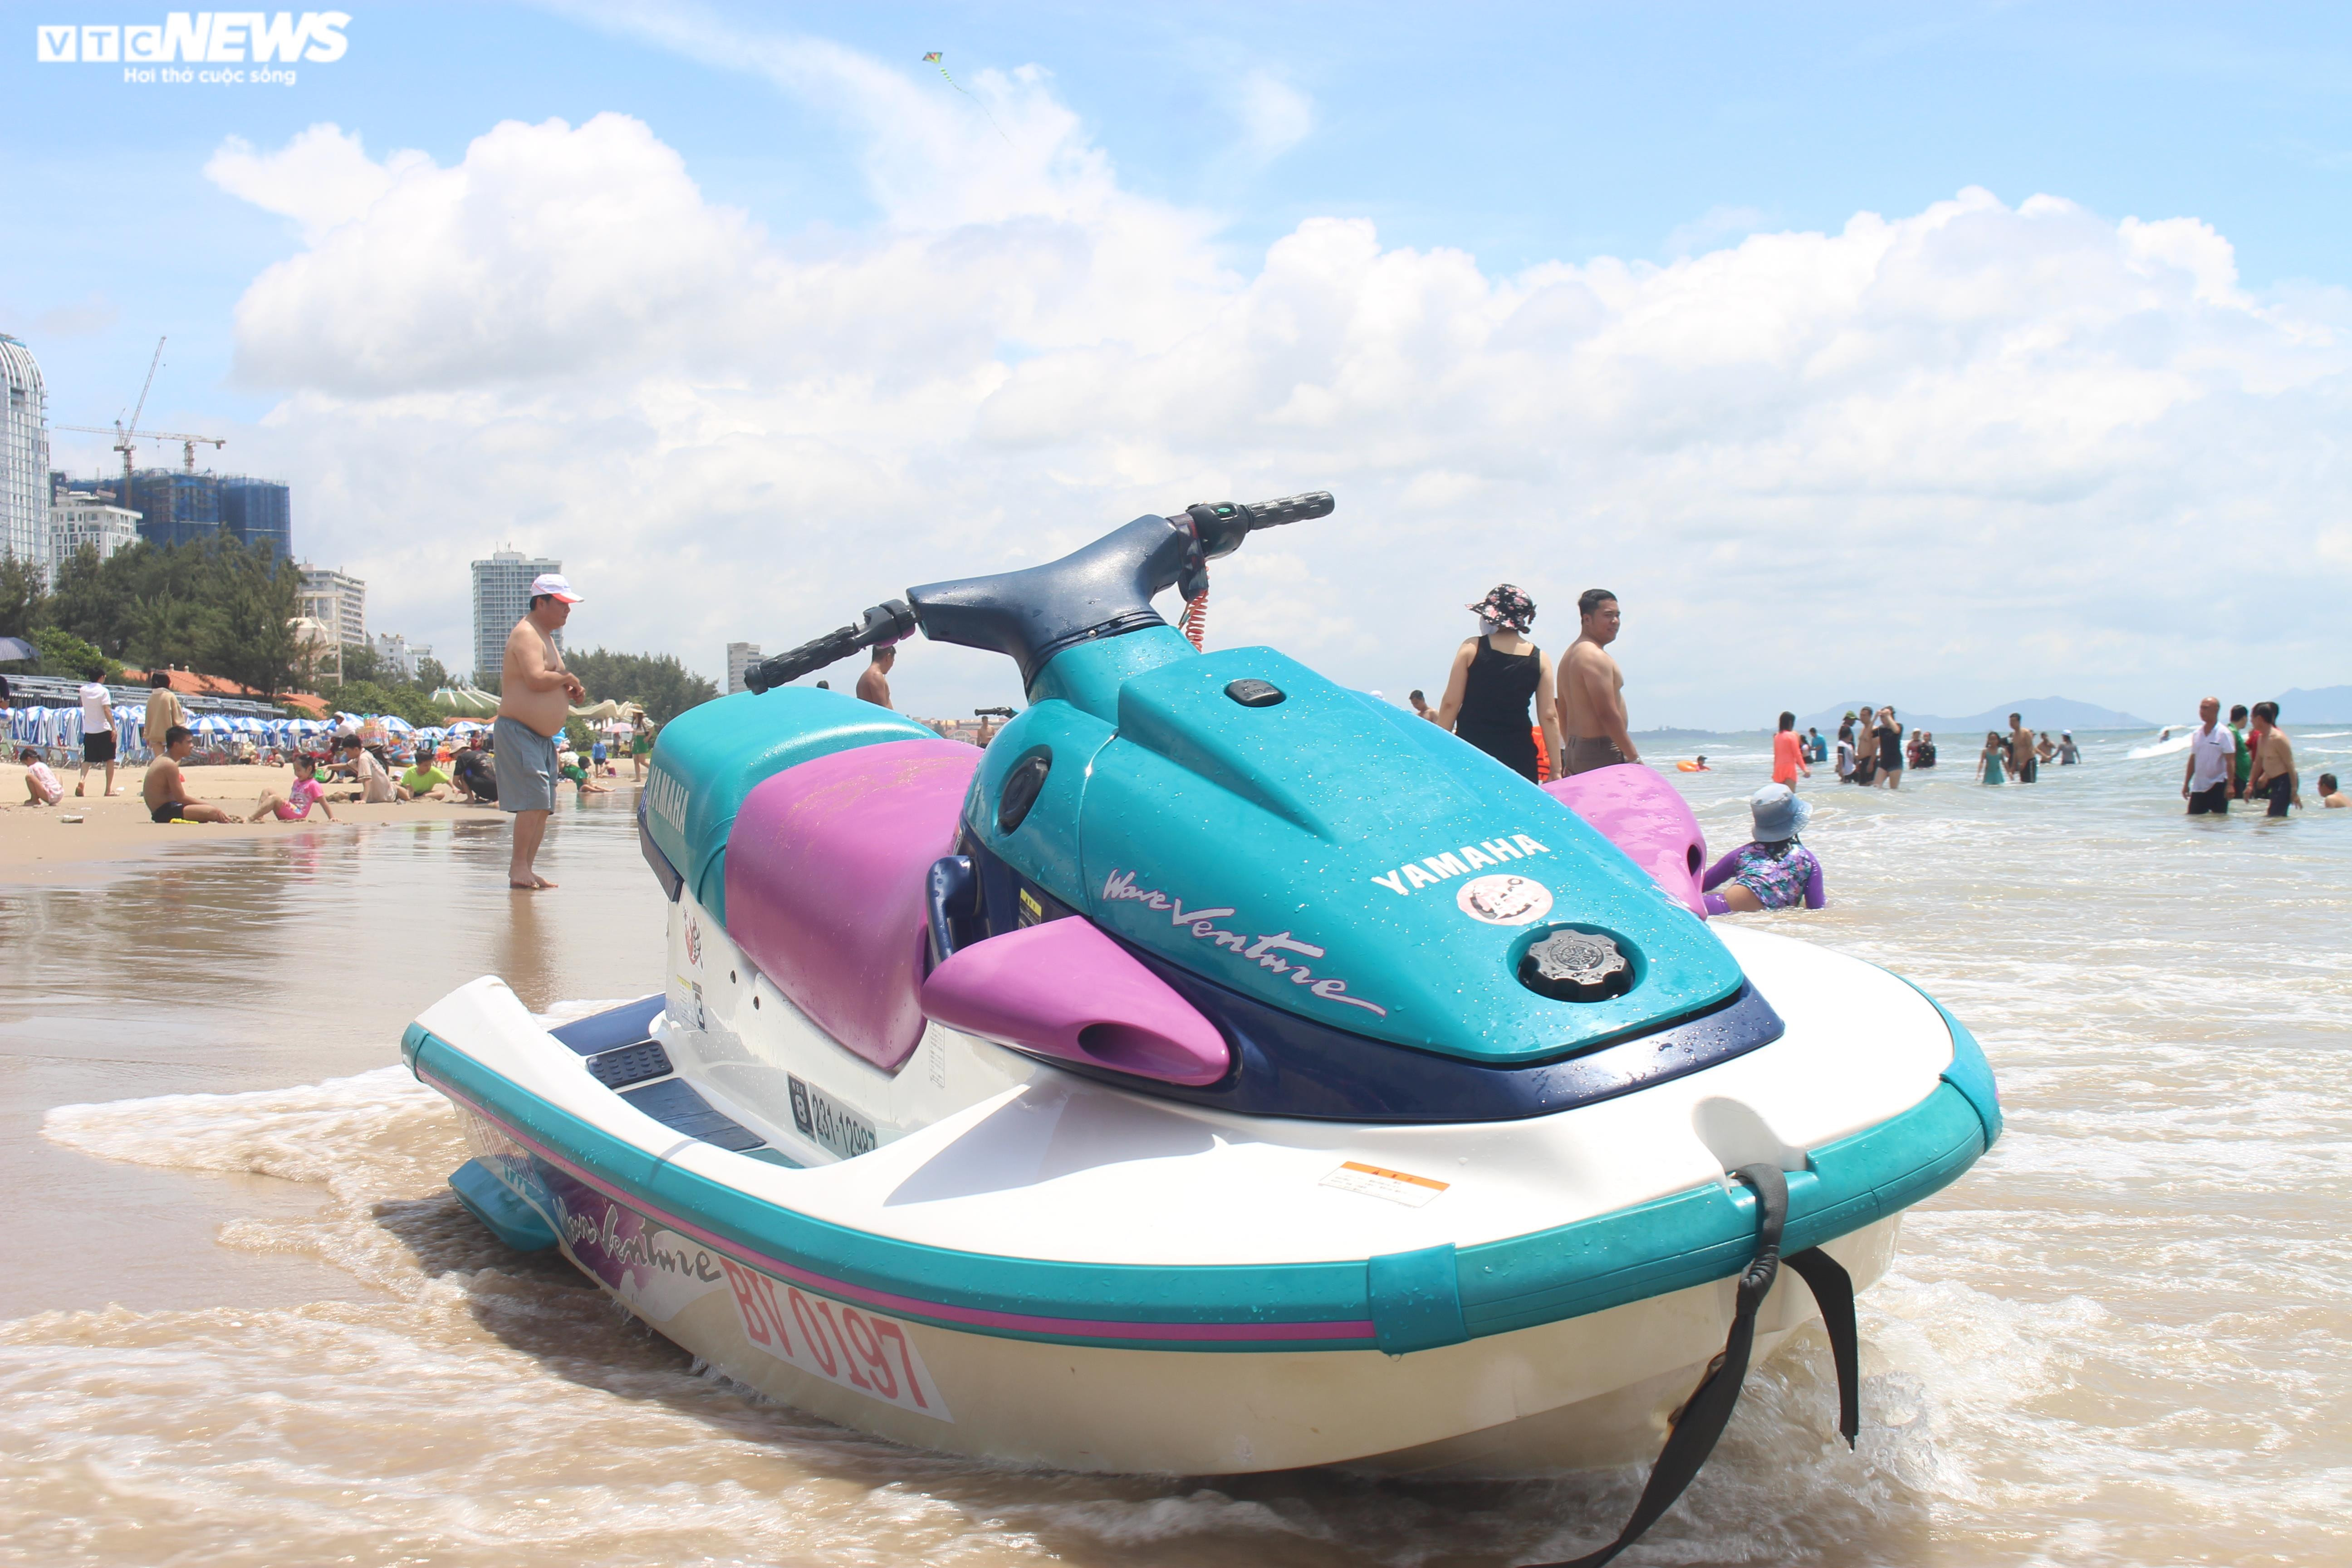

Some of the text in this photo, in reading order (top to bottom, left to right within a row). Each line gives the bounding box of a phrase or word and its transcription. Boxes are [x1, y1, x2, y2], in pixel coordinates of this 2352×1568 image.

[649, 764, 690, 835] YAMAHA
[1371, 834, 1551, 896] YAMAHA
[1103, 868, 1387, 1017] Wave Venture
[795, 1094, 808, 1124] 8
[590, 1204, 722, 1283] Venture
[718, 1255, 929, 1409] BV 0197
